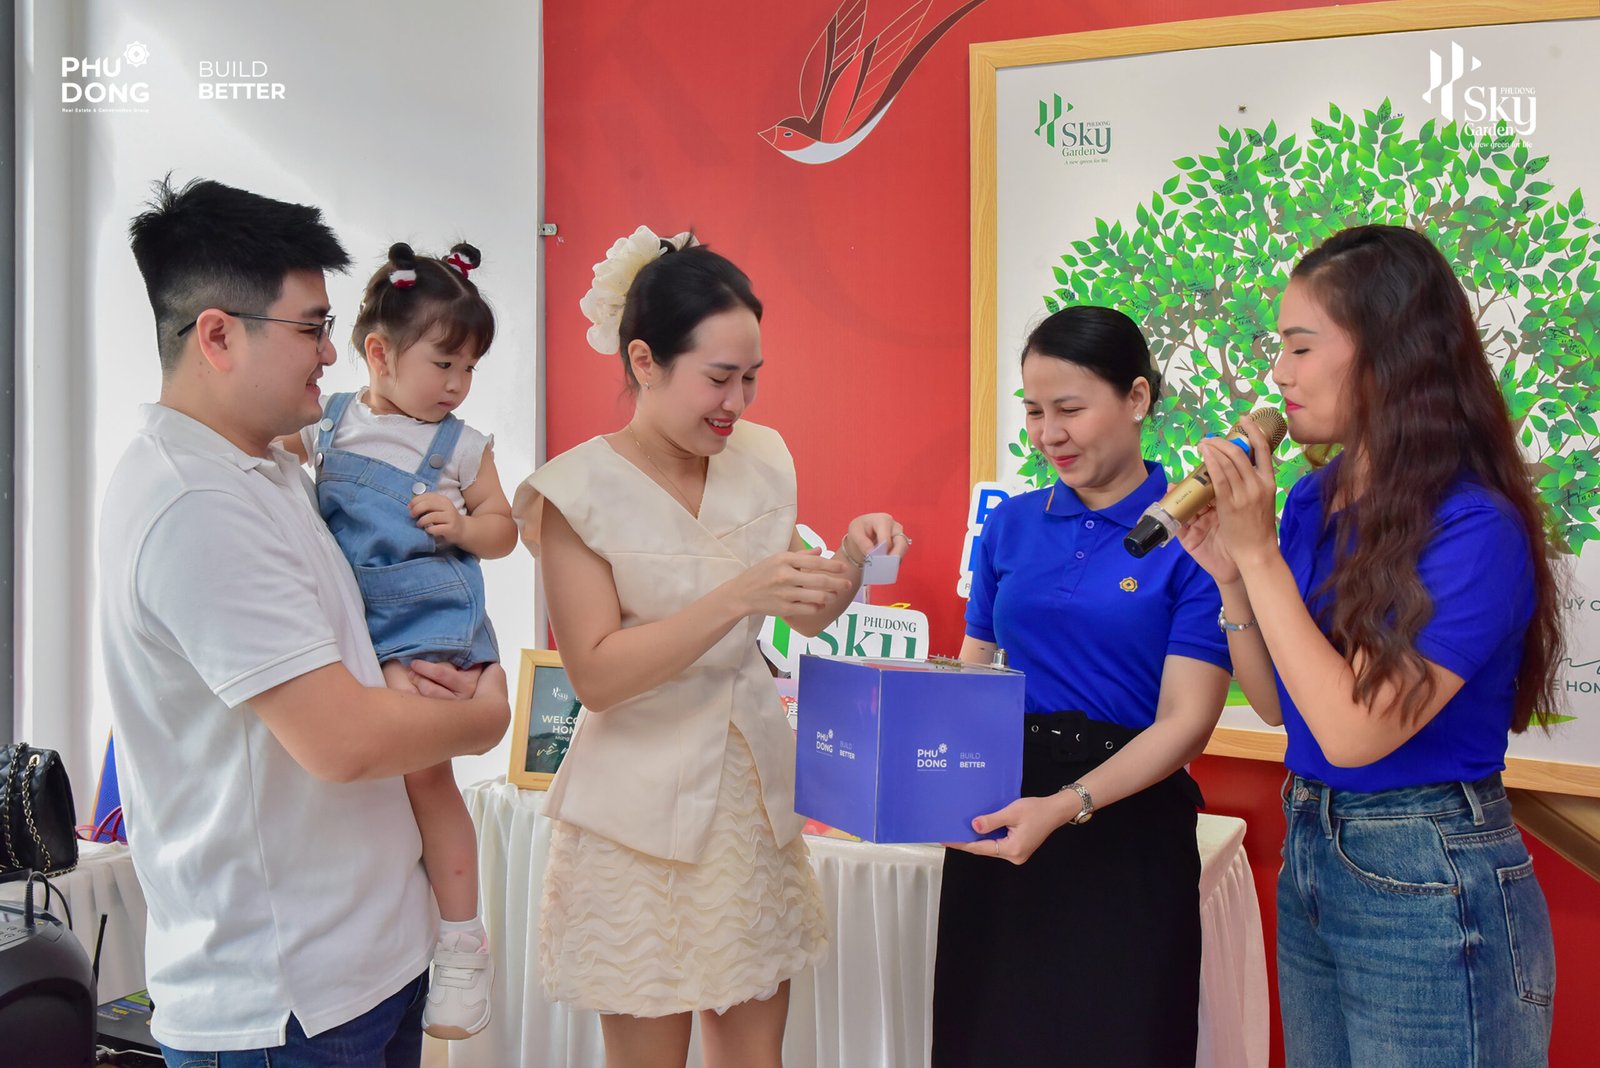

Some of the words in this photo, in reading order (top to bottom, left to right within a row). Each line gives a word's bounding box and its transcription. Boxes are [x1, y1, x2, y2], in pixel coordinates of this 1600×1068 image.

[1062, 122, 1111, 155] Sky
[1062, 147, 1096, 157] Garden
[1562, 596, 1585, 610] UÝ
[863, 615, 918, 634] PHUDONG
[816, 731, 829, 742] PHU
[816, 740, 833, 753] DONG
[839, 749, 855, 760] BETTER
[917, 749, 938, 758] PHU
[960, 752, 981, 760] BUILD
[917, 759, 947, 768] DONG
[959, 761, 986, 769] BETTER
